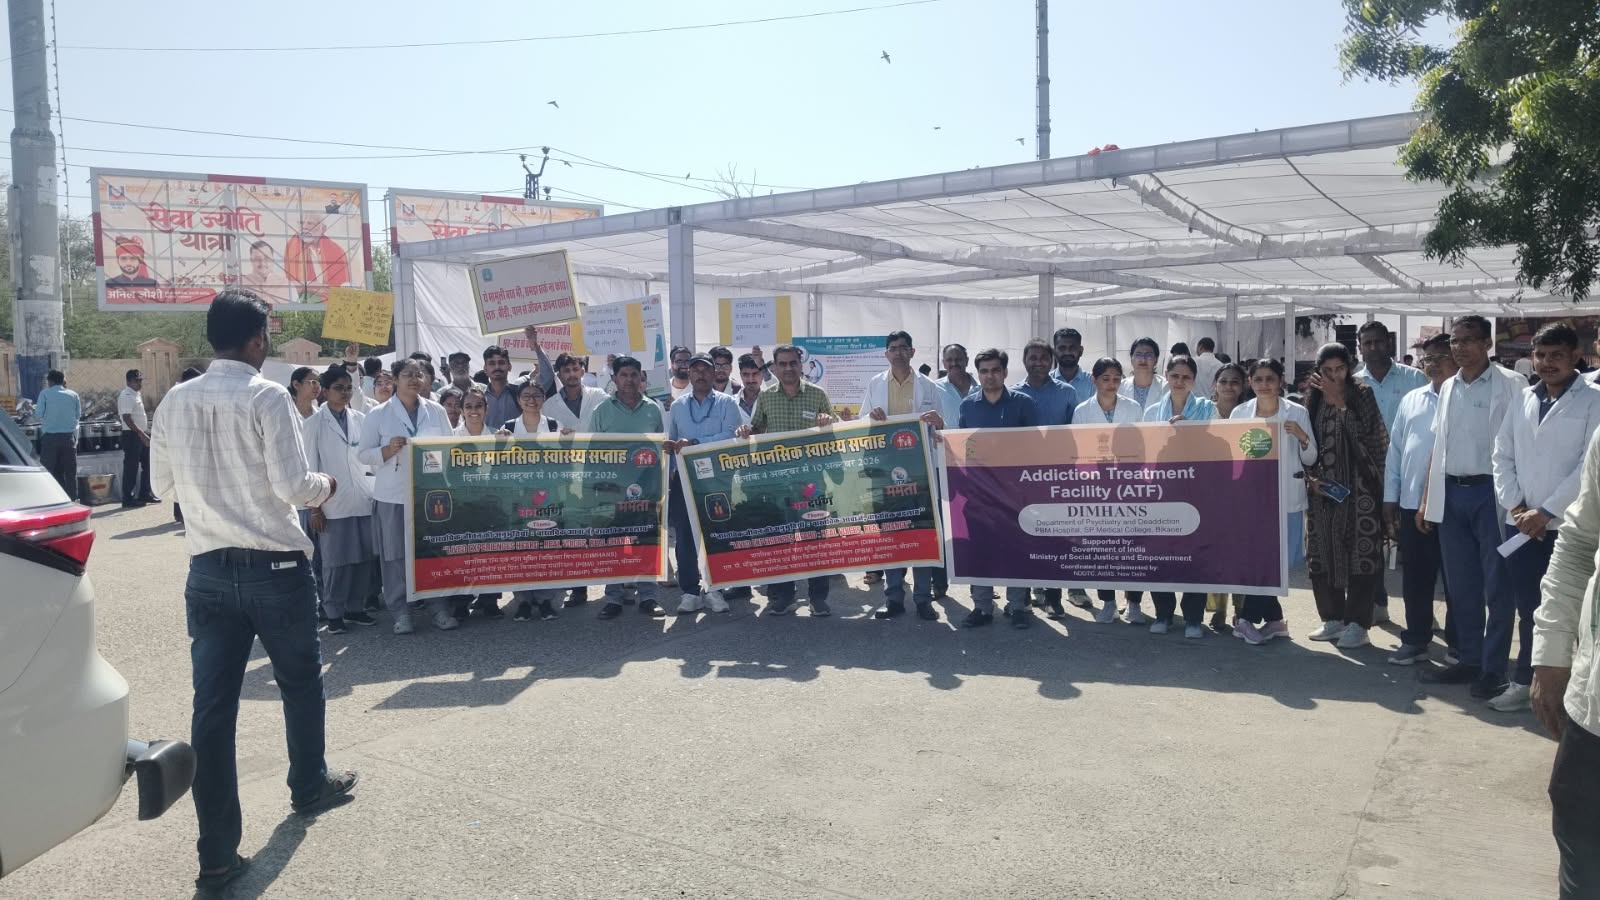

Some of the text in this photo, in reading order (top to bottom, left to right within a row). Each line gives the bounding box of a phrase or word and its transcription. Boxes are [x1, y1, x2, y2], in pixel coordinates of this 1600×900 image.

[142, 201, 265, 237] सेवा ज्योति
[179, 230, 236, 251] यात्रा
[107, 289, 135, 299] अनिल
[450, 446, 628, 468] विश्व मानसिक स्वास्थ्य सप्ताह
[719, 434, 887, 472] विश्व मानसिक स्वास्थ्य सप्ताह
[462, 471, 490, 482] दिनांक
[548, 471, 558, 480] 10
[1020, 466, 1195, 482] Addiction Treatment
[1050, 484, 1163, 500] Facility (ATF)
[1068, 506, 1148, 518] DIMHANS
[1086, 518, 1121, 526] Psychiatry
[1082, 538, 1121, 546] Supported
[1029, 553, 1058, 562] Ministry
[1136, 554, 1192, 562] Empowerment
